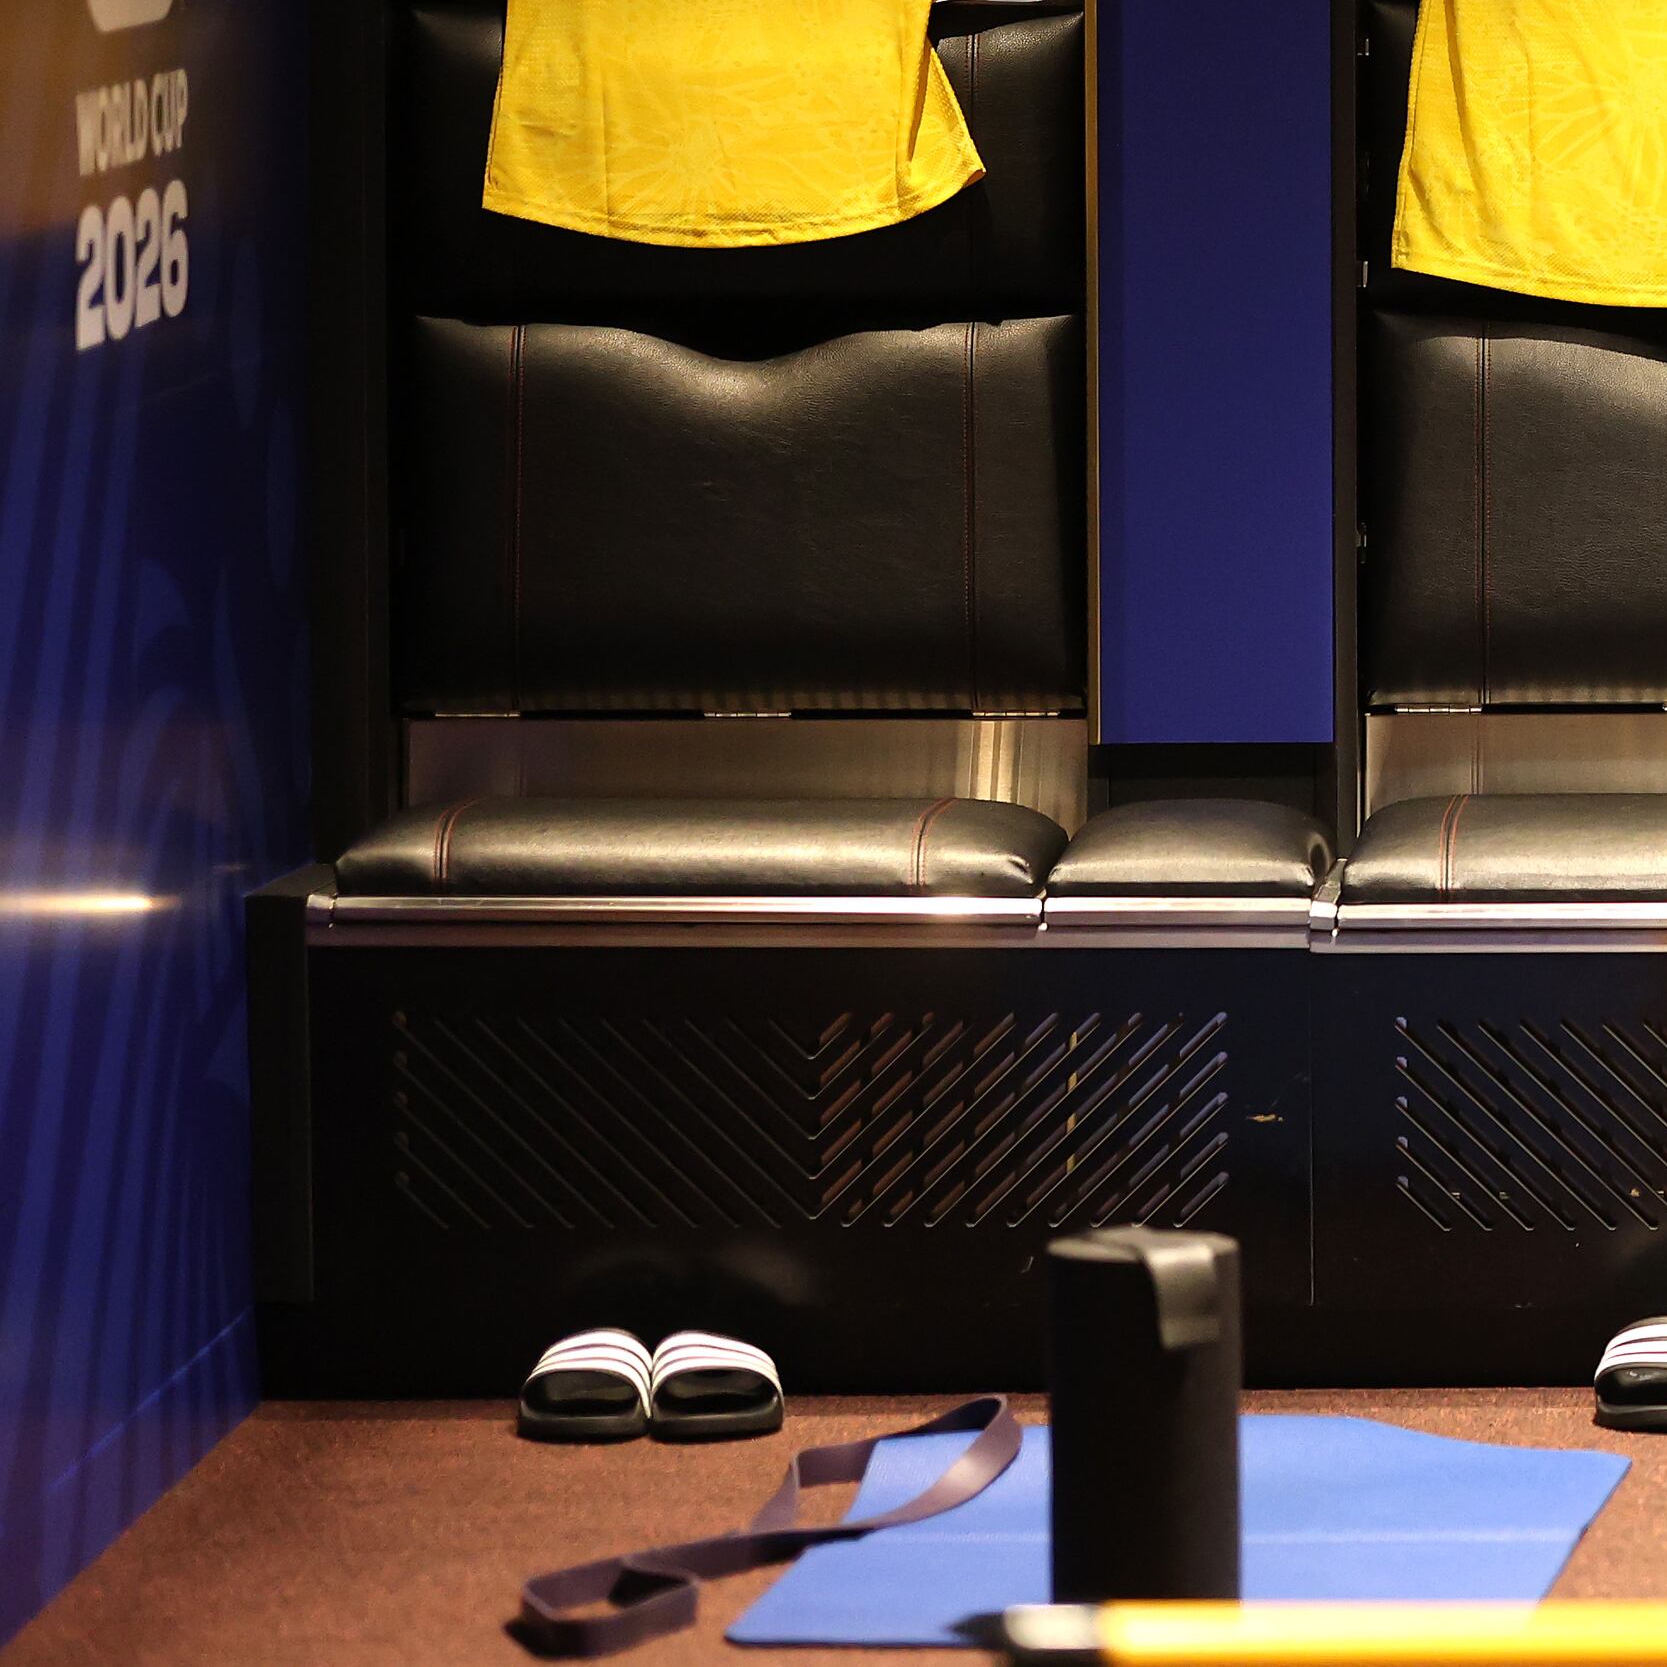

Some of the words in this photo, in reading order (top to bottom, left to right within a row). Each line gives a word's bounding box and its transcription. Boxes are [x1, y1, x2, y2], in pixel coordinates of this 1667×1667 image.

[75, 78, 148, 176] WORLD
[151, 67, 189, 157] CUP
[74, 178, 190, 352] 2026
